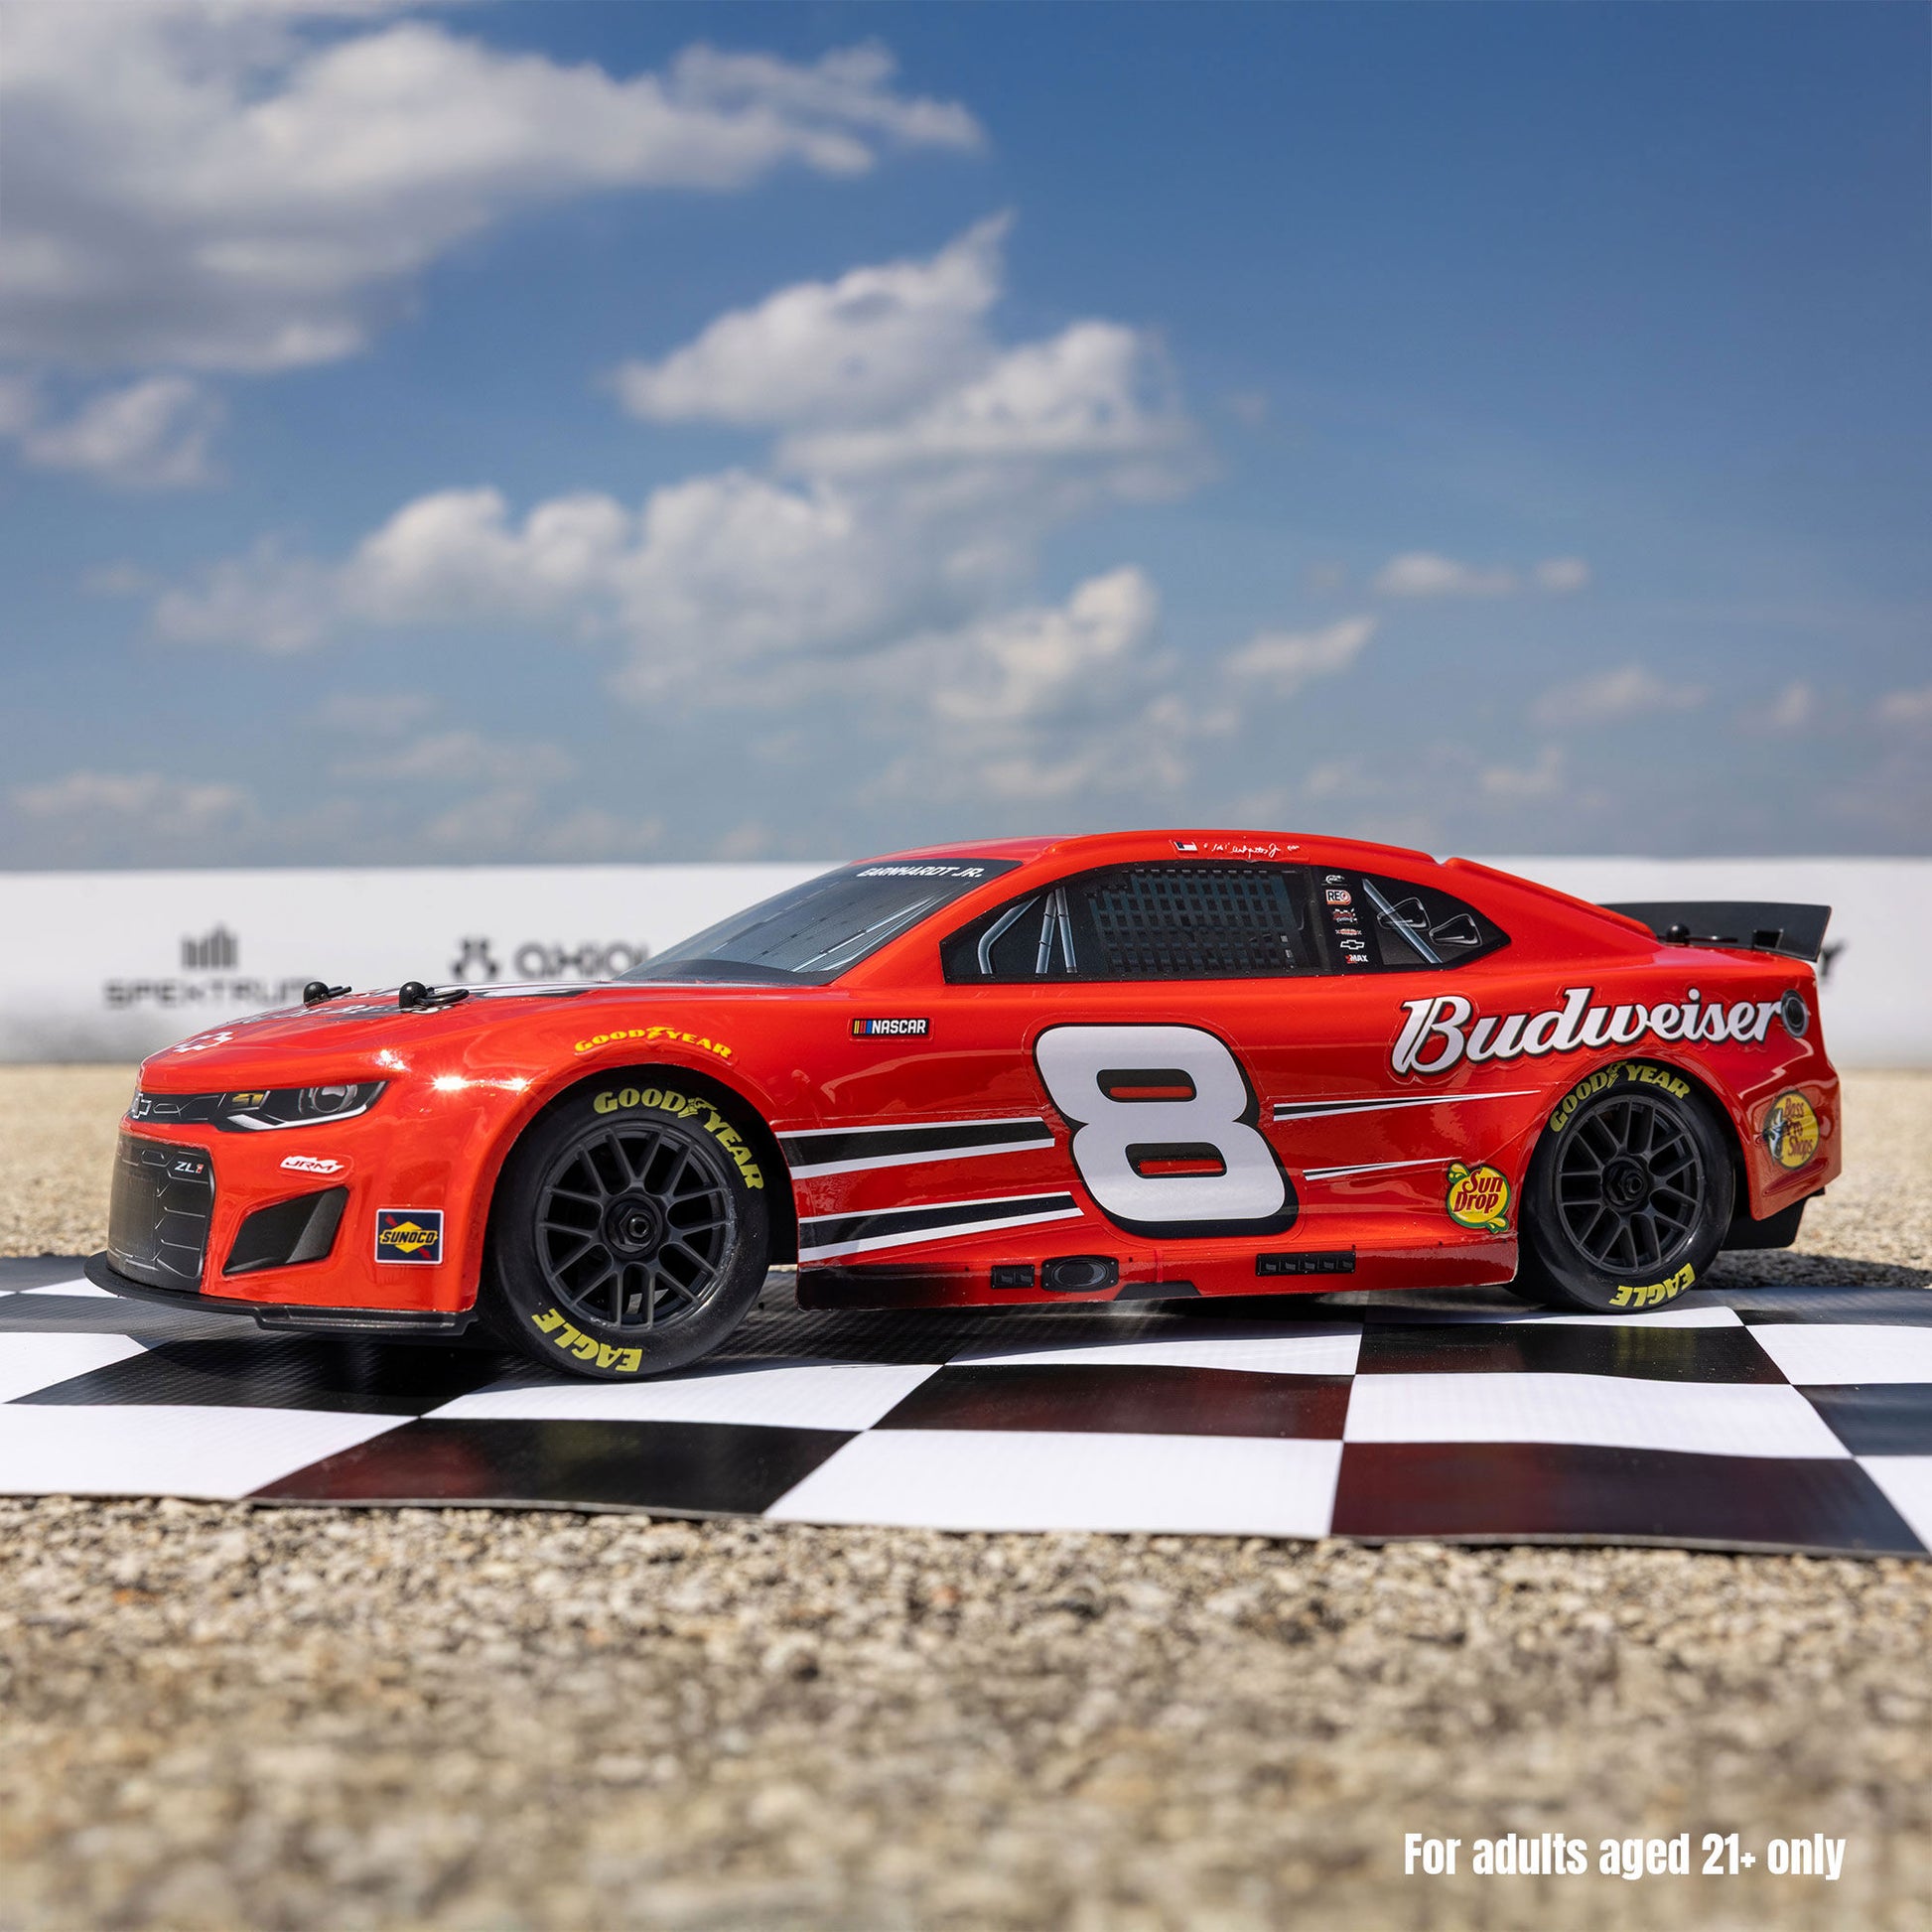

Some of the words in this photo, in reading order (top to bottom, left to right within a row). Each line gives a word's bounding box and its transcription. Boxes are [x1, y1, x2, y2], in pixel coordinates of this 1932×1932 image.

[856, 867, 960, 878] EARNHARDT
[951, 868, 985, 878] JR.
[872, 1019, 926, 1035] NASCAR
[1391, 987, 1783, 1075] Budweiser
[1034, 1024, 1296, 1236] 8
[175, 1161, 205, 1173] ZL1
[286, 1160, 334, 1171] JRM
[1461, 1170, 1504, 1194] Sun
[1452, 1190, 1499, 1214] Drop
[381, 1230, 437, 1245] SUNOCO
[1608, 1262, 1696, 1308] EAGLE
[531, 1308, 643, 1372] EAGLE
